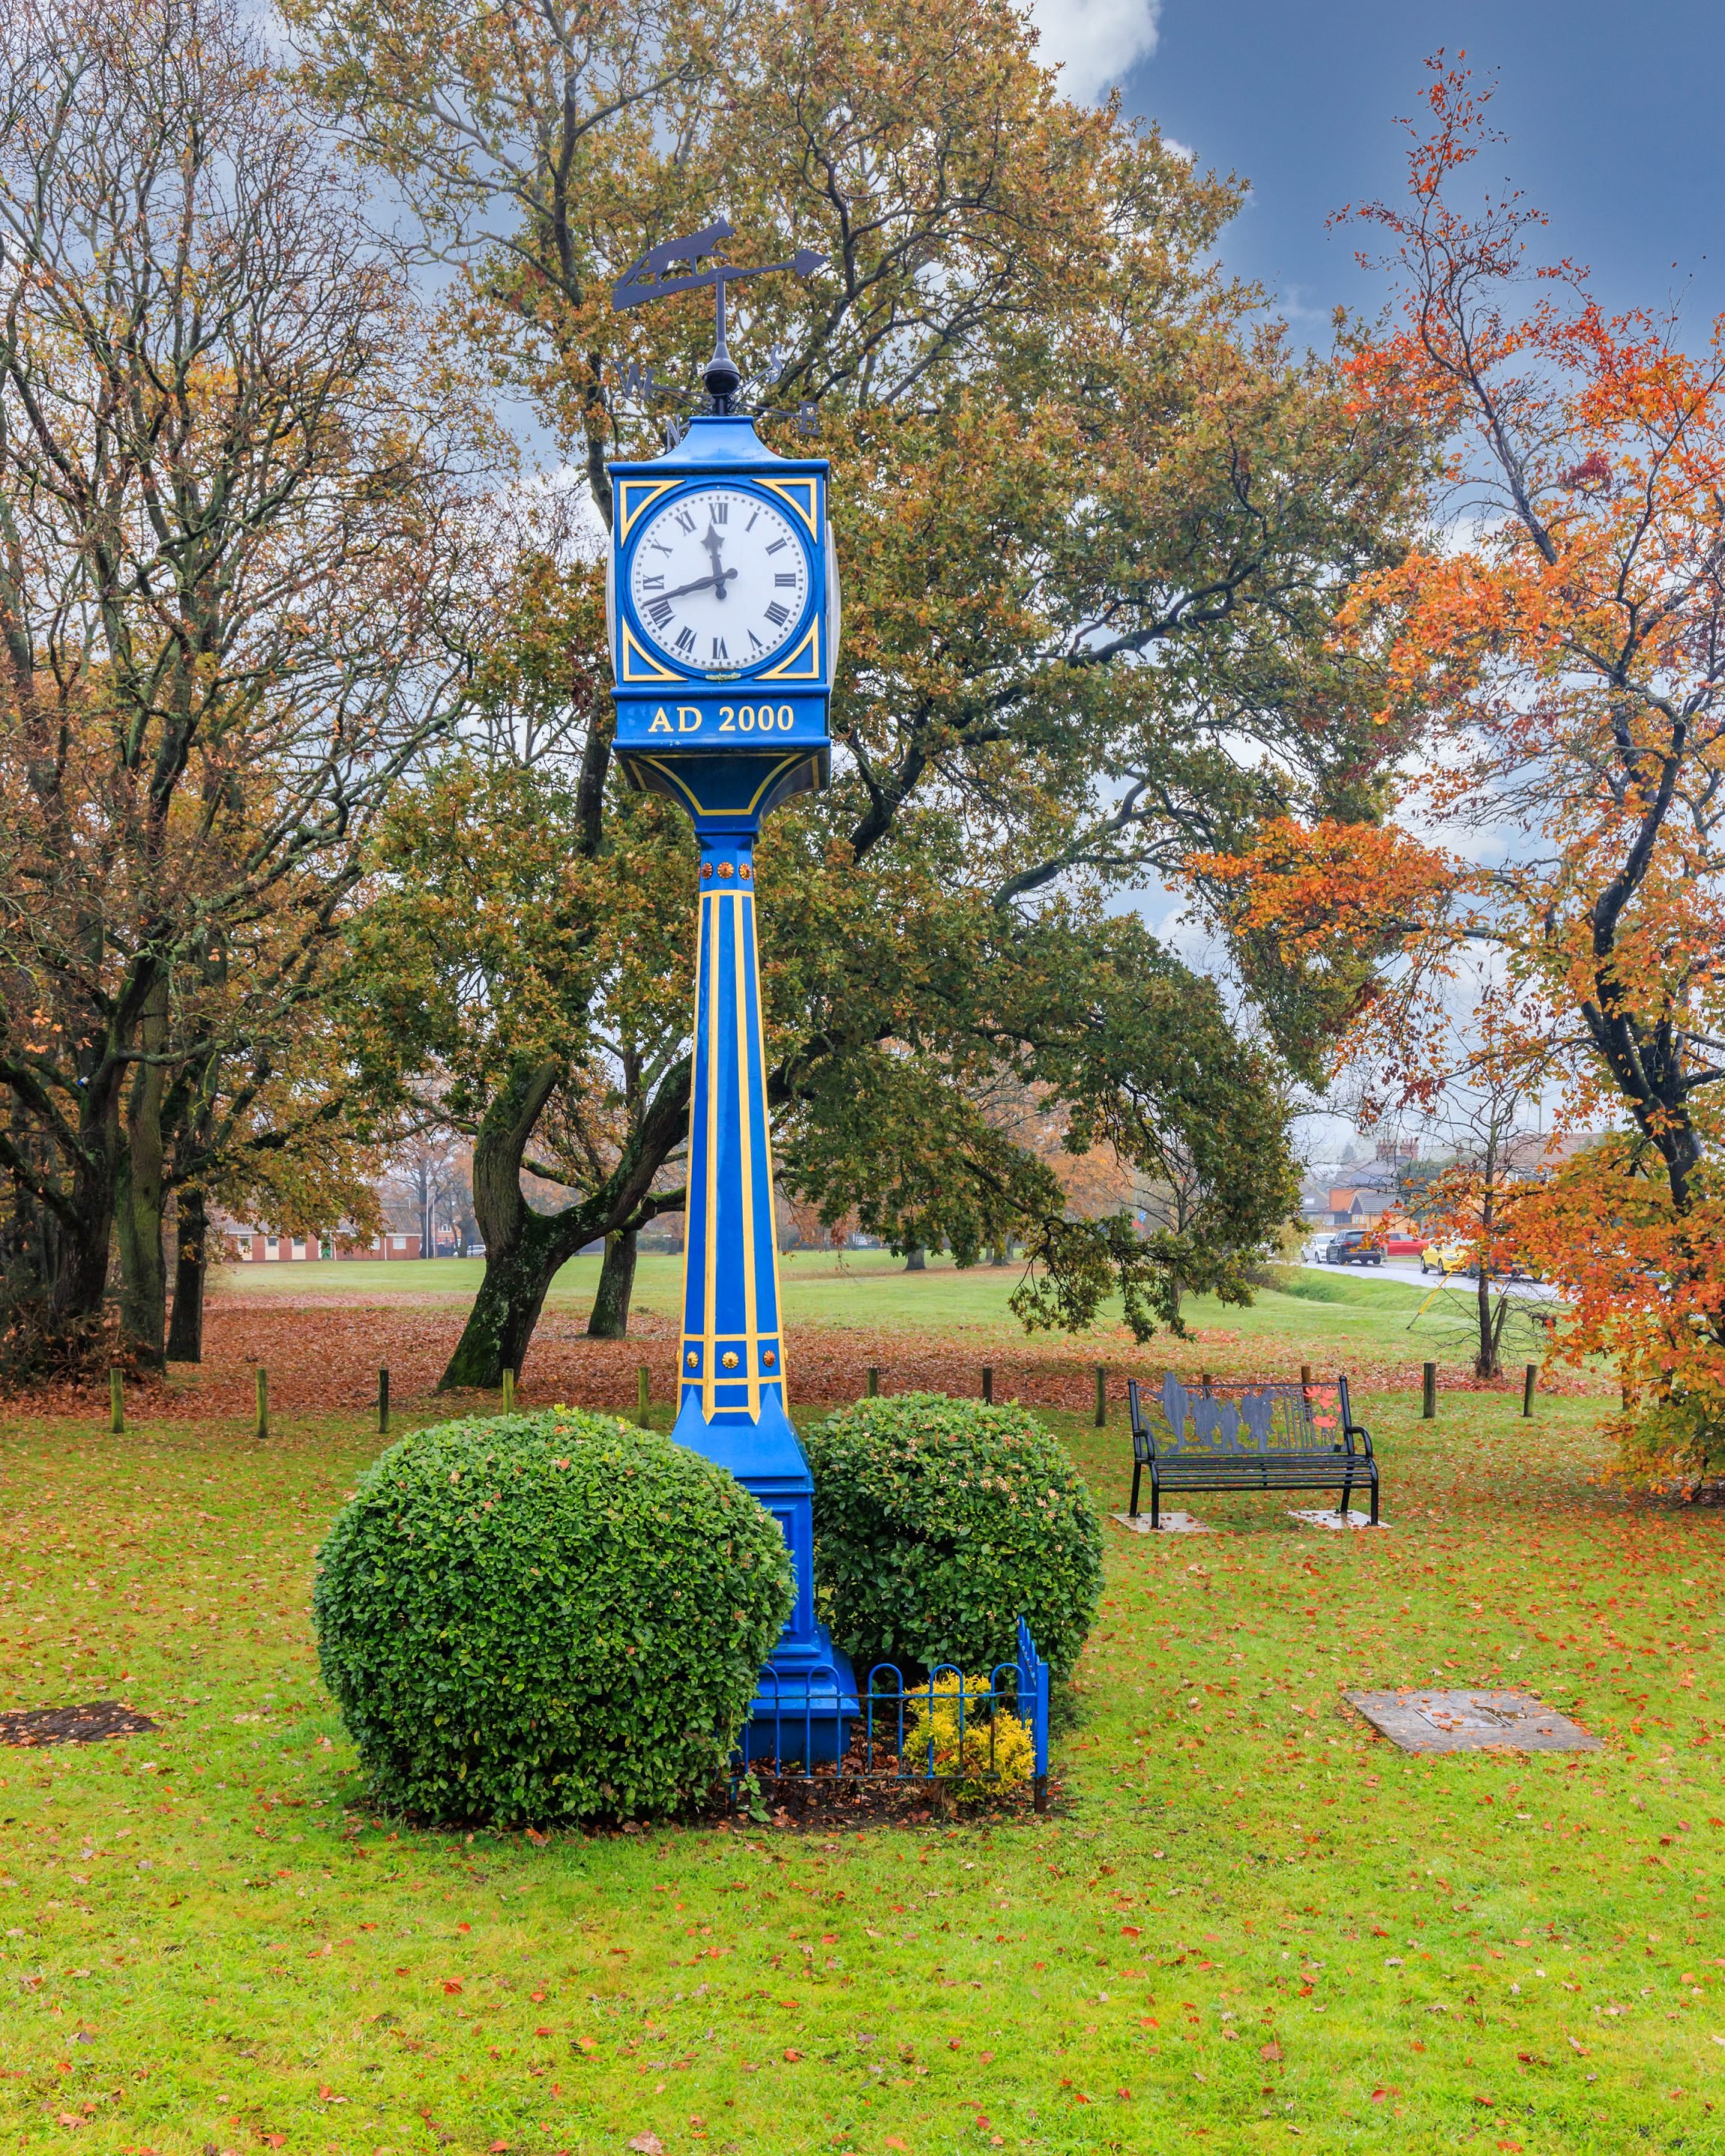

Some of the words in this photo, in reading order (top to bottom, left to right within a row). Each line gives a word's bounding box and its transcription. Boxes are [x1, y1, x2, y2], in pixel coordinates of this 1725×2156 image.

[613, 361, 654, 400] W
[798, 401, 819, 437] E
[674, 511, 697, 536] XI
[708, 502, 728, 525] XII
[745, 511, 758, 532] I
[651, 538, 673, 558] X
[765, 537, 788, 555] II
[642, 573, 665, 591] IX
[774, 573, 797, 588] III
[648, 599, 677, 631] VIII
[763, 600, 791, 627] IIII
[674, 625, 697, 654] VII
[712, 636, 728, 660] VI
[747, 629, 763, 651] V
[648, 707, 702, 733] AD
[719, 705, 794, 731] 2000
